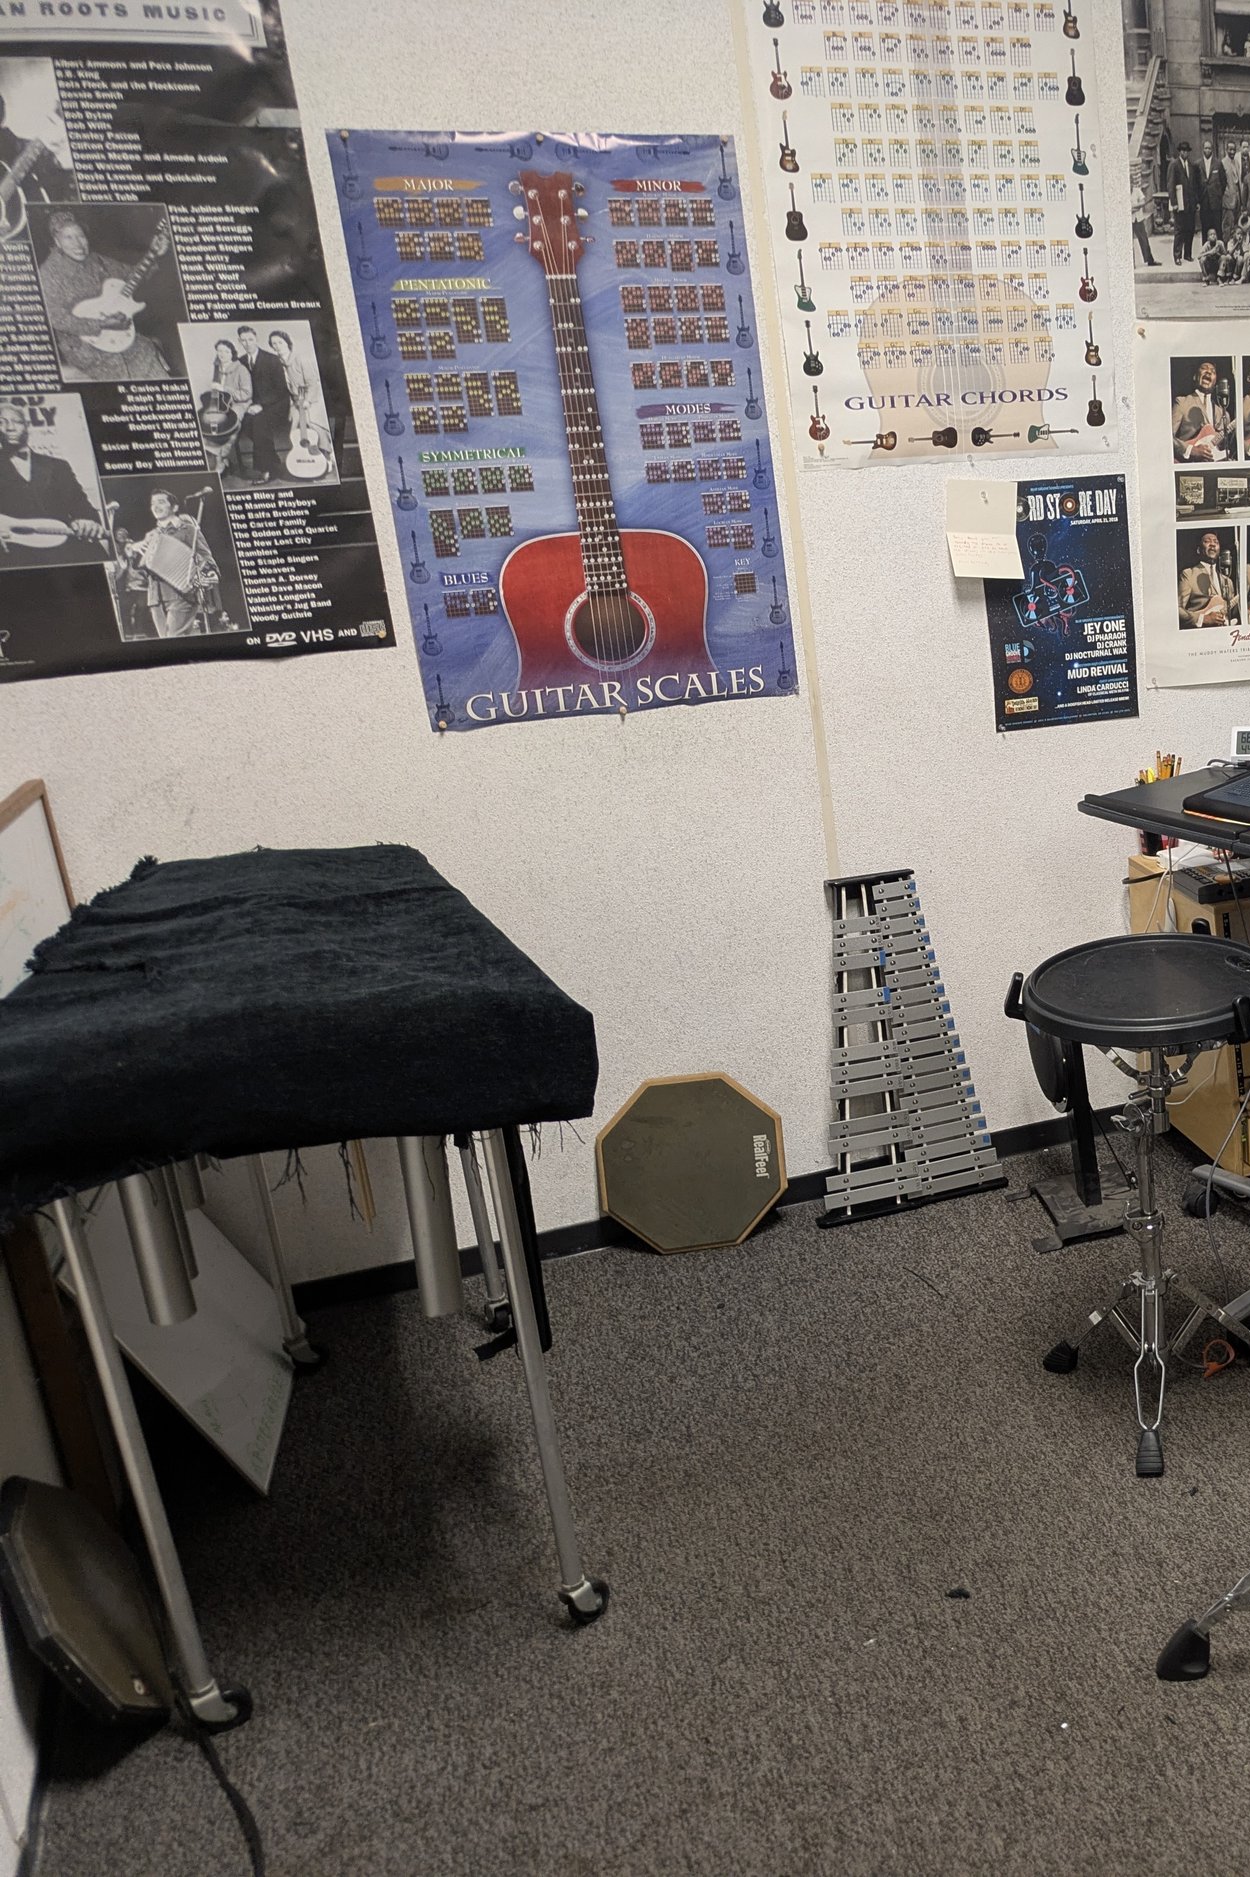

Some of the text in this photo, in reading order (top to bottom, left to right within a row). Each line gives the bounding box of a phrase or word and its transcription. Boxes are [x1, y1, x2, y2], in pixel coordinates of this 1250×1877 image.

[41, 2, 128, 17] ROOTS
[144, 4, 226, 21] MUSIC
[404, 179, 454, 192] MAJOR
[636, 180, 681, 191] MINOR
[400, 278, 491, 290] PENTATONIC
[844, 388, 1069, 410] GUITAR CHORDS
[156, 403, 192, 411] Johnson
[665, 404, 711, 415] MODES
[423, 448, 525, 462] SYMMETRICAL
[245, 502, 276, 510] Mamou
[278, 499, 317, 508] Playboys
[1095, 489, 1116, 515] DAY
[273, 509, 309, 517] Brothers
[279, 518, 306, 526] Family
[252, 530, 281, 538] Golden
[284, 528, 303, 536] Gate
[306, 525, 338, 535] Quartet
[258, 557, 285, 566] Staple
[287, 555, 319, 563] Singers
[444, 573, 488, 585] BLUES
[246, 587, 270, 595] Uncle
[294, 602, 309, 610] Jug
[252, 611, 312, 622] Woody Guthrie
[1083, 620, 1126, 635] JEY ONE
[247, 637, 261, 645] ON
[266, 632, 296, 643] DVD
[300, 629, 334, 643] VHS
[338, 629, 357, 637] AND
[1096, 632, 1126, 641] PHARAOH
[1005, 643, 1020, 651] BLUE
[1105, 640, 1126, 648] CRANK
[1074, 649, 1112, 659] NOCTURNAL
[1113, 647, 1127, 655] WAX
[1068, 668, 1089, 679] MUD
[1091, 663, 1128, 677] REVIVAL
[1077, 685, 1096, 693] LINDA
[1097, 681, 1128, 691] CARDUCCI
[466, 666, 765, 721] GUITAR SCALES
[753, 1134, 769, 1179] RealFeel
